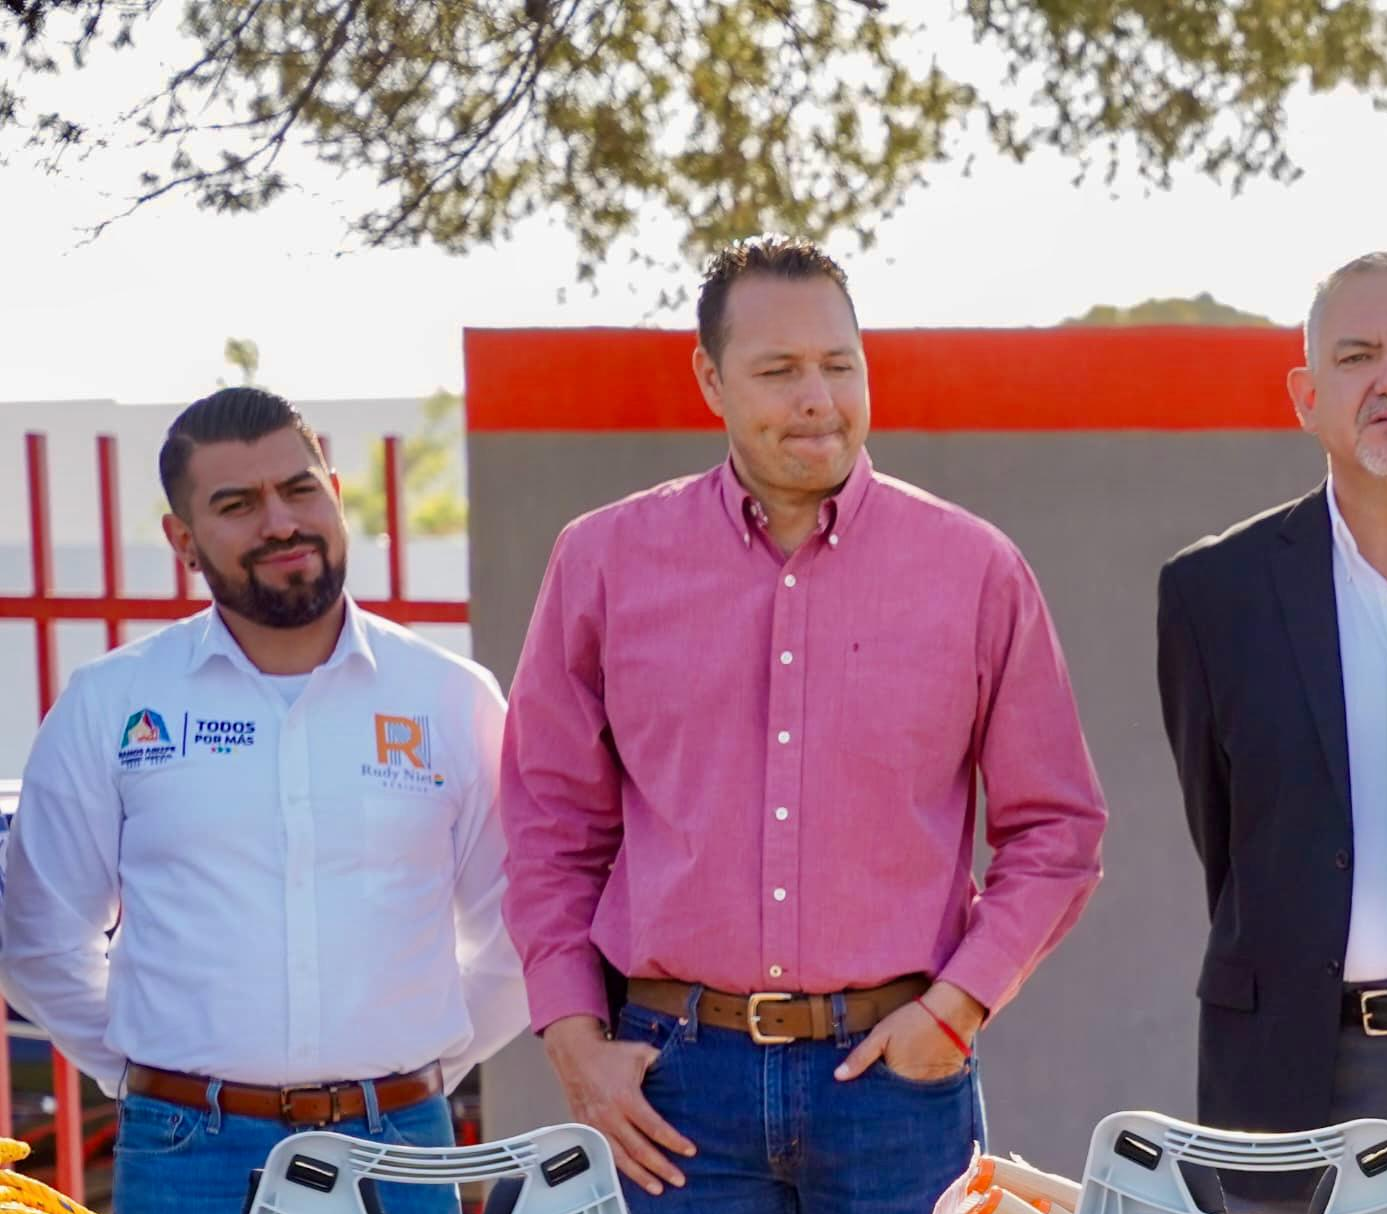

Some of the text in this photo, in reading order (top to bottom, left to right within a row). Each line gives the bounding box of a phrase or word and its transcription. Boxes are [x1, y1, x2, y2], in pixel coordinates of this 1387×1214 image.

[196, 720, 256, 734] TODOS
[195, 733, 255, 745] POR MÁS
[361, 764, 399, 780] Rudy
